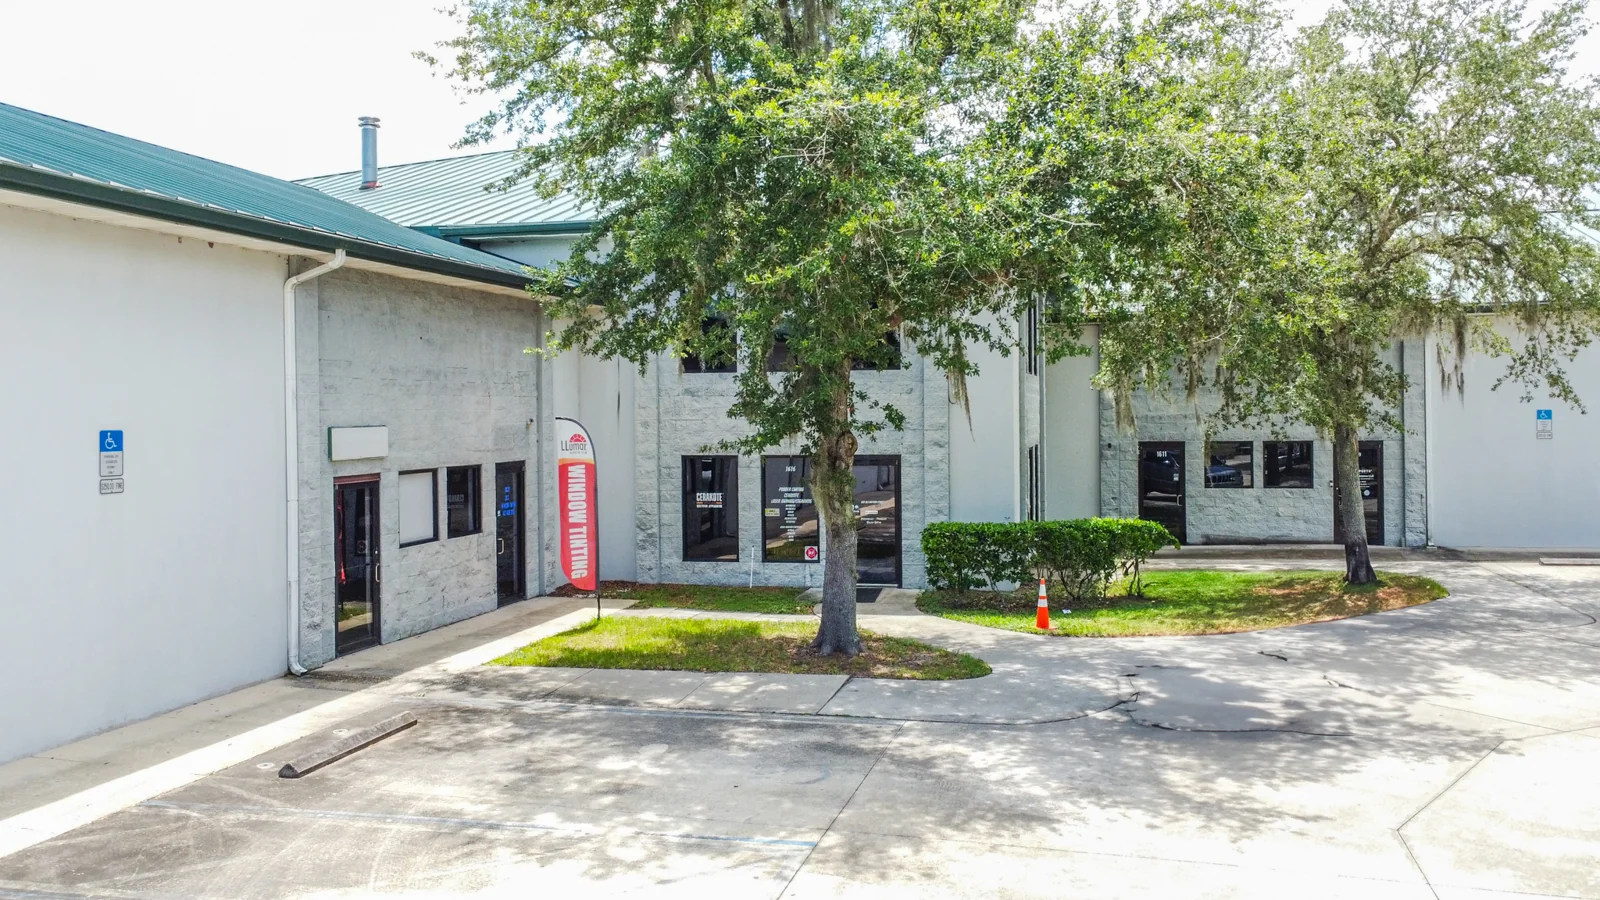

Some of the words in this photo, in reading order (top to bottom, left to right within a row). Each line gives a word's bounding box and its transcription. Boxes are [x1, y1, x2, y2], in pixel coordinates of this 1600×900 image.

[568, 464, 587, 524] WINDOW
[696, 492, 723, 502] CERAKOTE
[569, 526, 588, 579] TINTING
